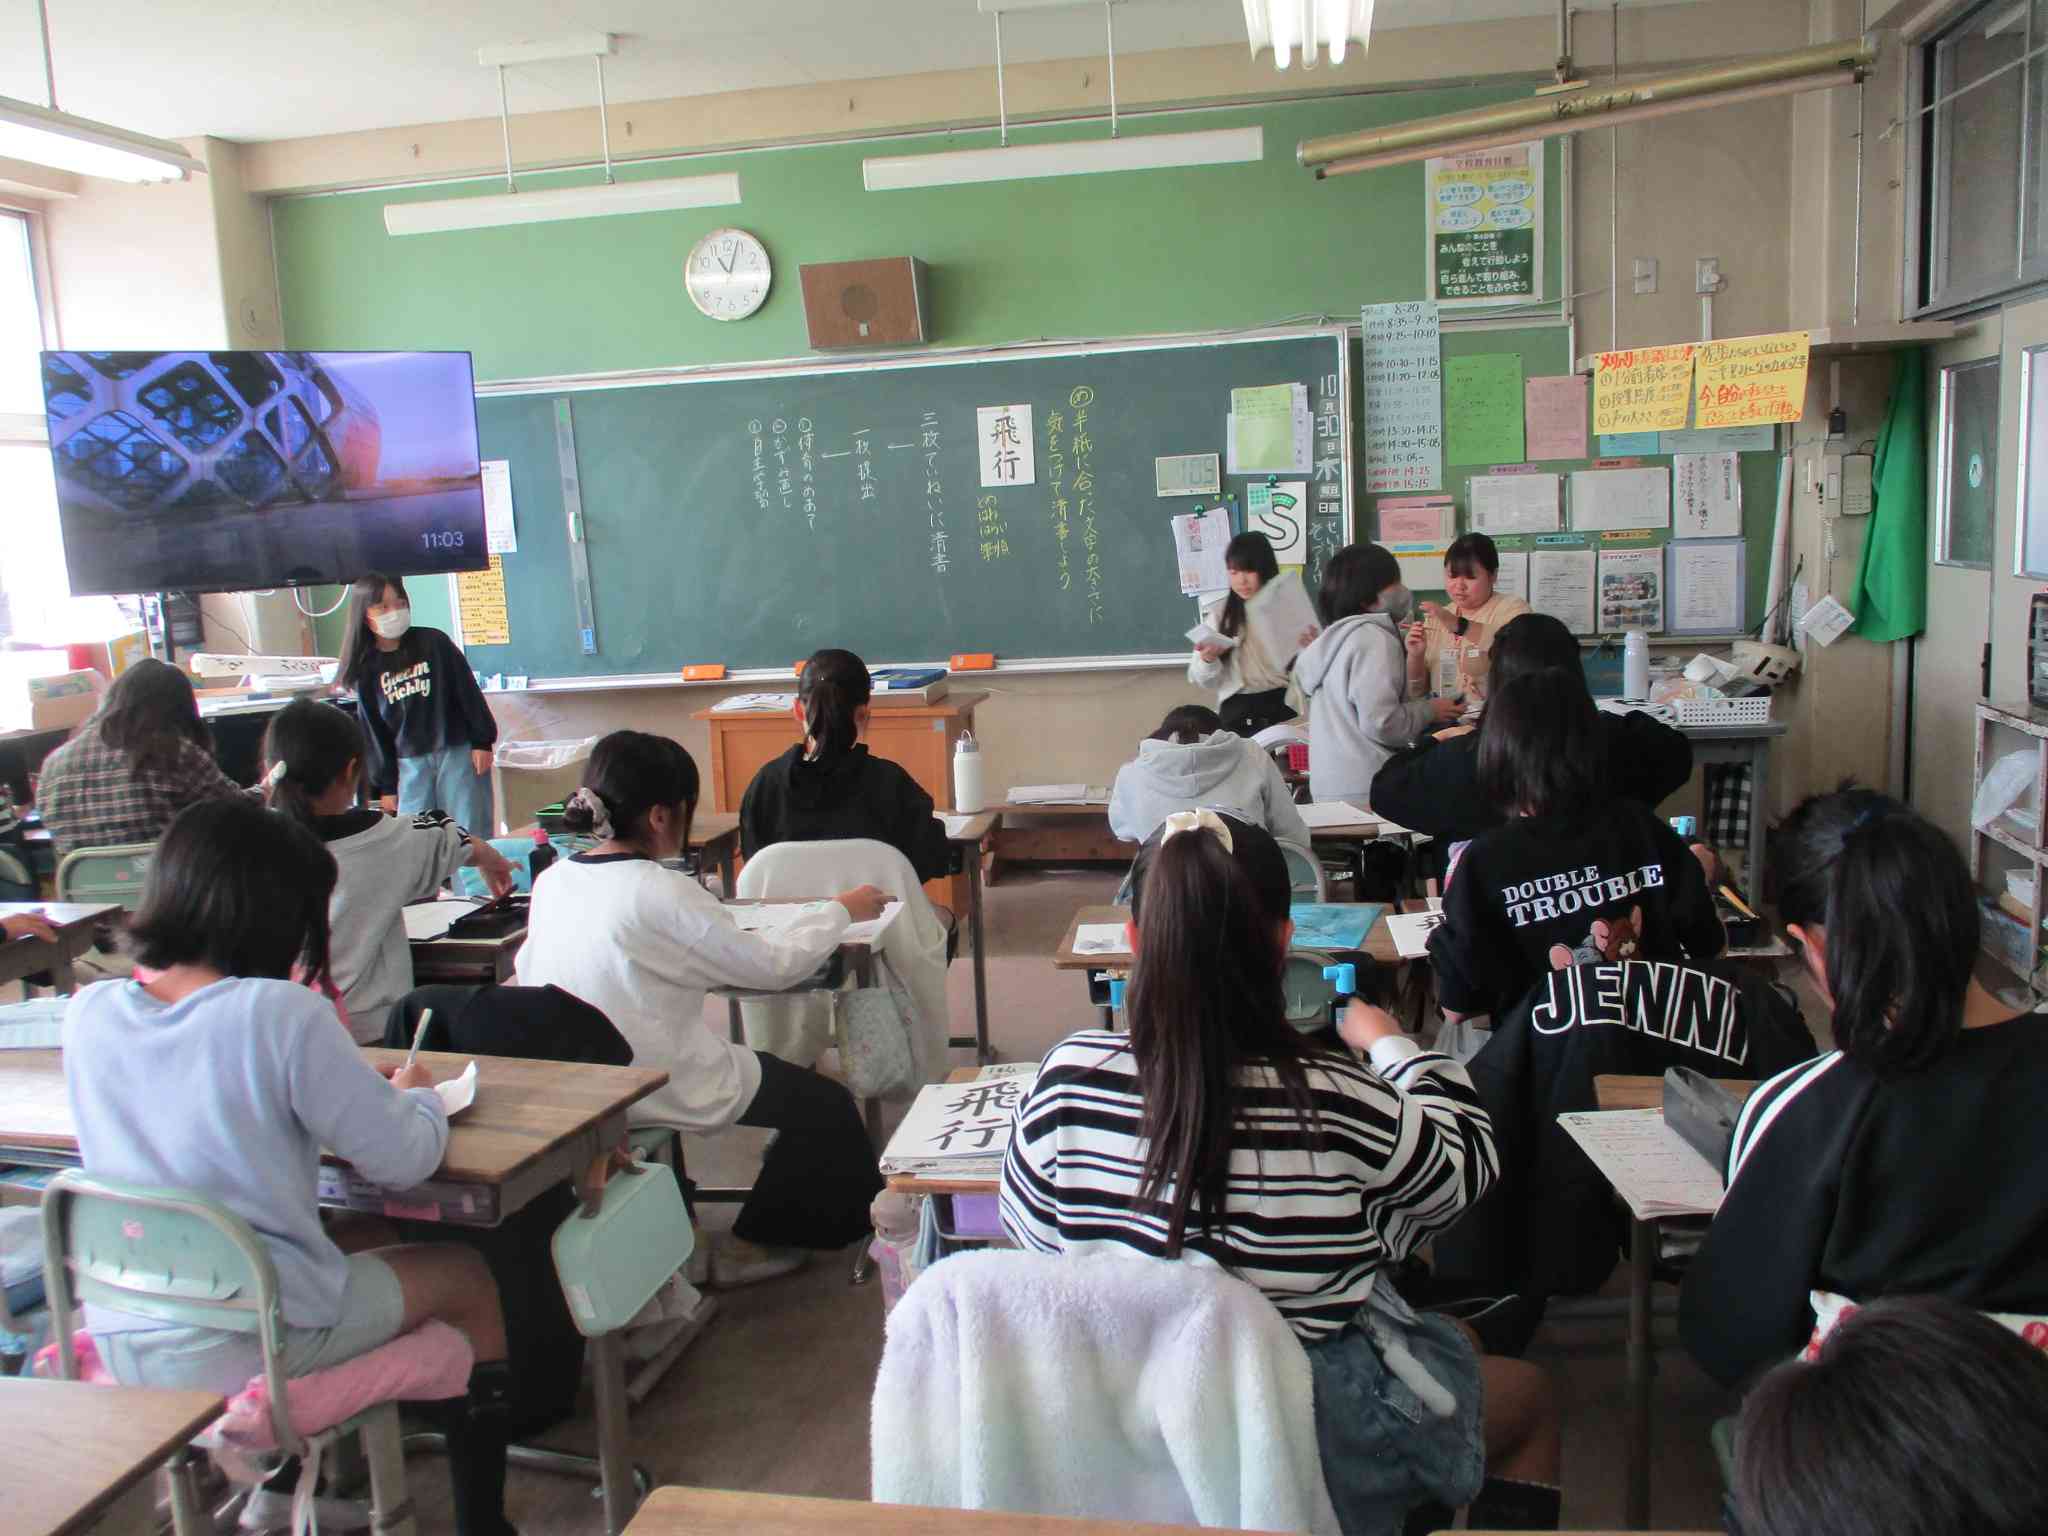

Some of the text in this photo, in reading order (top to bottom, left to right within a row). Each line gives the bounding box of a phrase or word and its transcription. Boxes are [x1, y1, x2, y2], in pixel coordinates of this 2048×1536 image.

[989, 415, 1022, 481] 飛行
[421, 531, 464, 549] 11:03
[1502, 864, 1601, 904] DOUBLE
[1506, 863, 1665, 928] TROUBLE
[926, 1081, 1021, 1151] 飛行
